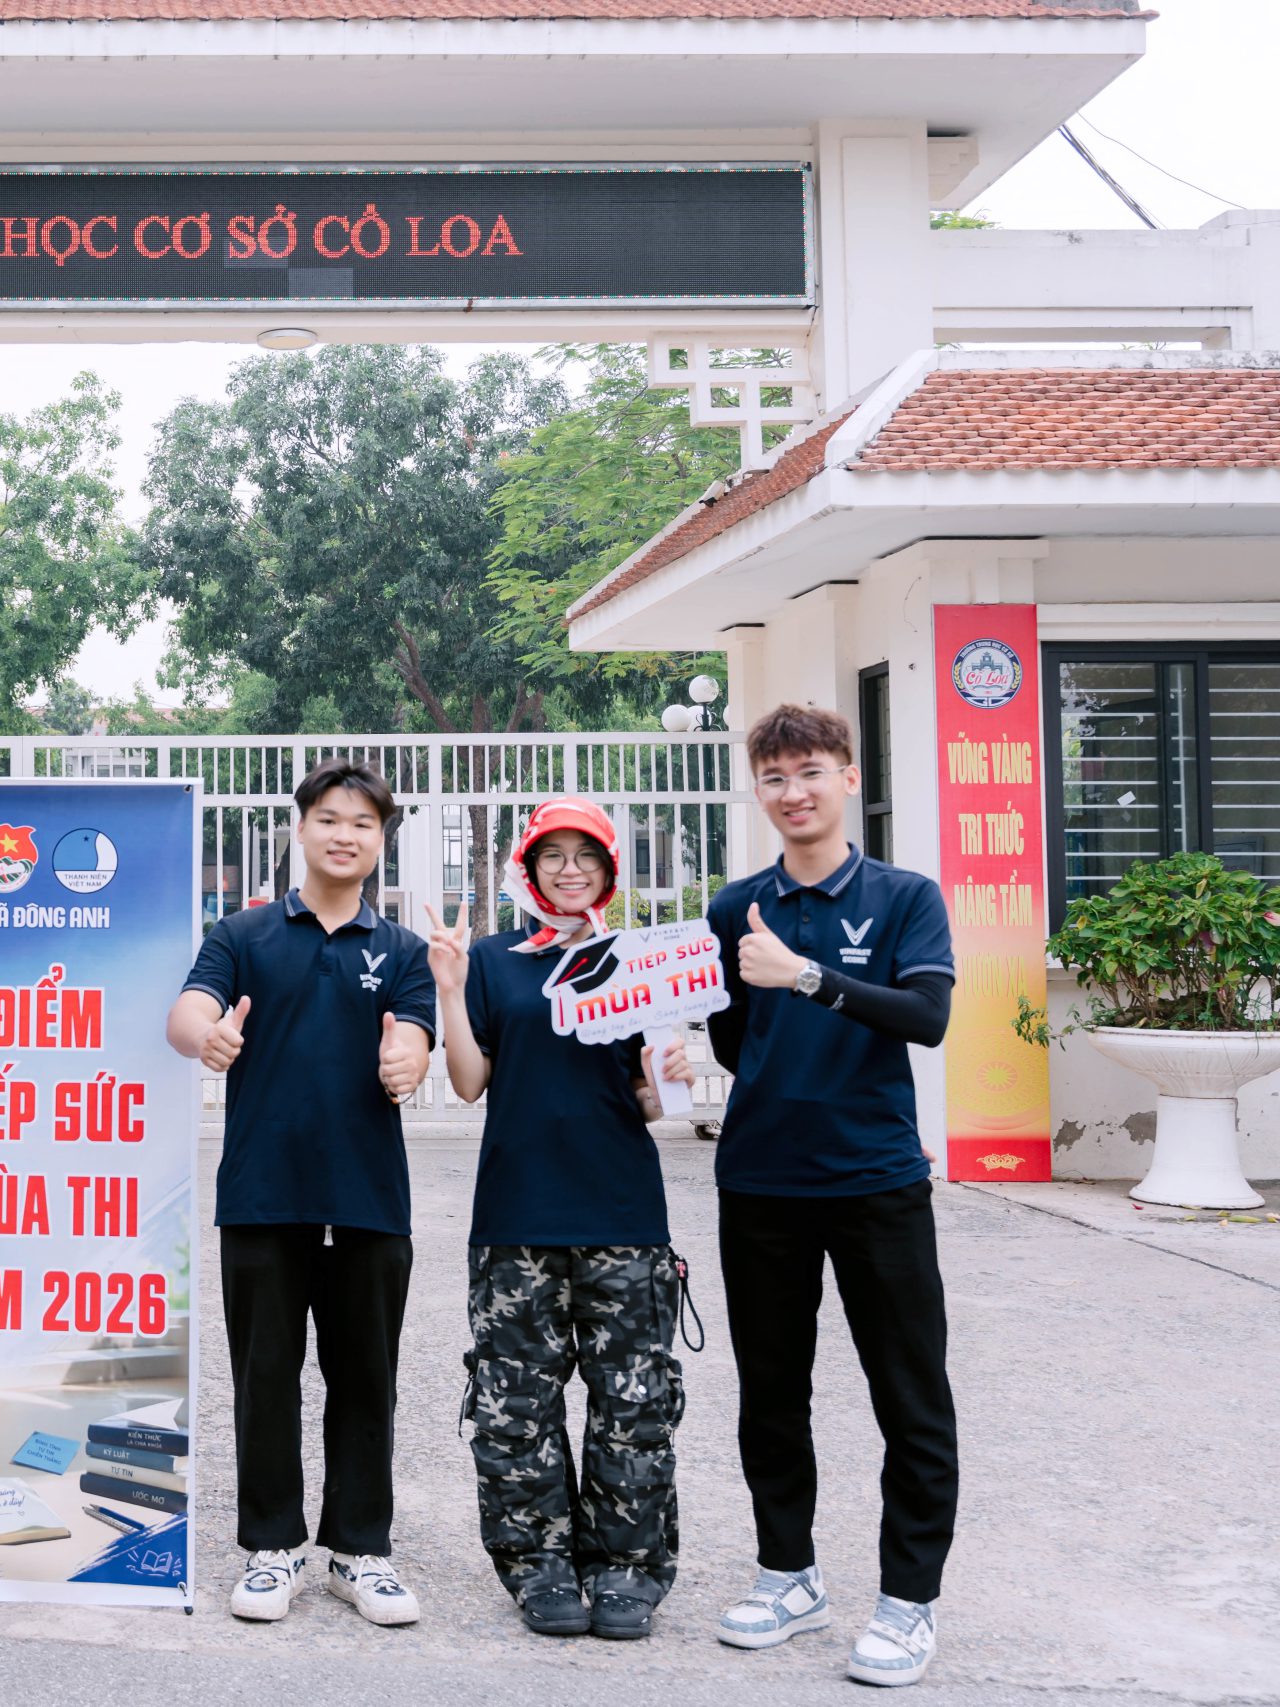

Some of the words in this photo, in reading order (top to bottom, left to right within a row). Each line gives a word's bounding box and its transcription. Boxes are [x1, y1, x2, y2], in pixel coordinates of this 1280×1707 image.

[0, 215, 118, 266] HỌC
[133, 212, 212, 259] CƠ
[227, 203, 297, 258] SỞ
[405, 214, 523, 258] LOA
[947, 731, 988, 784] VỮNG
[991, 733, 1032, 784] VÀNG
[958, 813, 983, 855] TRI
[985, 800, 1025, 855] THỨC
[12, 903, 66, 928] ĐÔNG
[69, 906, 110, 928] ANH
[953, 875, 997, 928] NÂNG
[575, 982, 651, 1024] MÙA
[665, 964, 718, 997] THI
[54, 1072, 145, 1142] SỨC
[67, 1176, 138, 1238] THI
[42, 1271, 166, 1335] 2026
